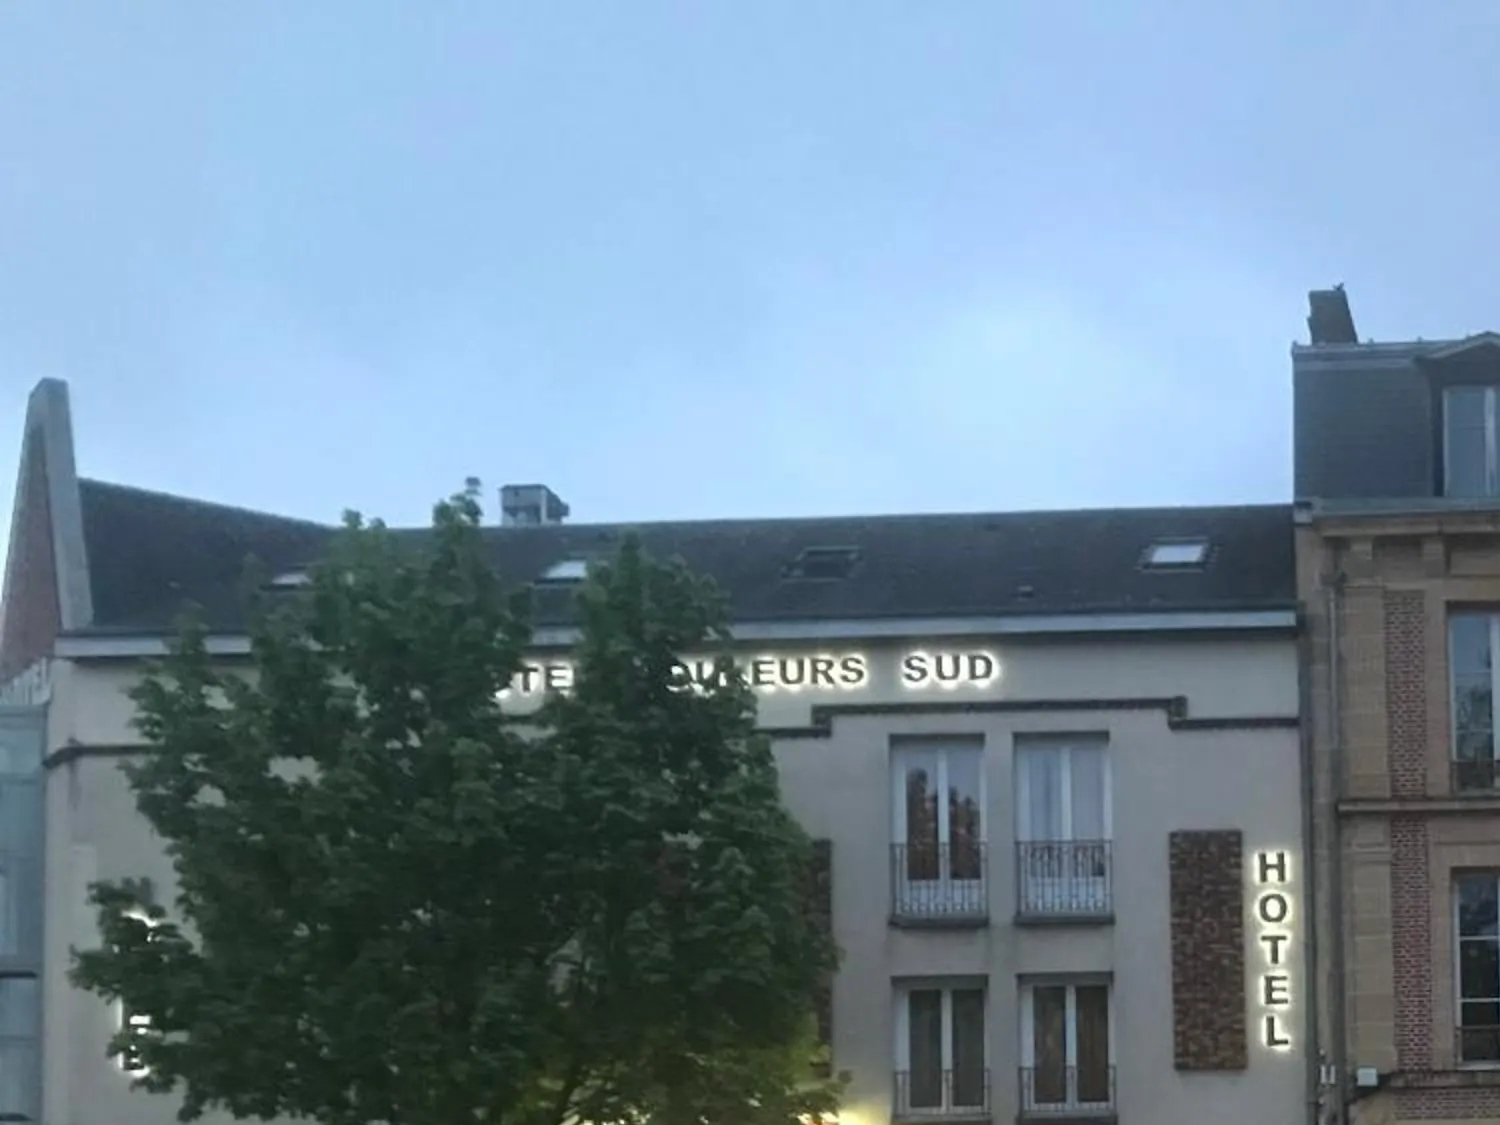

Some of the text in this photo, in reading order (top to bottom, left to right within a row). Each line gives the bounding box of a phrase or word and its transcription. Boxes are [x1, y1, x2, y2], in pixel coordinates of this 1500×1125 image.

[640, 653, 995, 690] OUEURS SUD
[1257, 851, 1290, 1047] HOTEL
